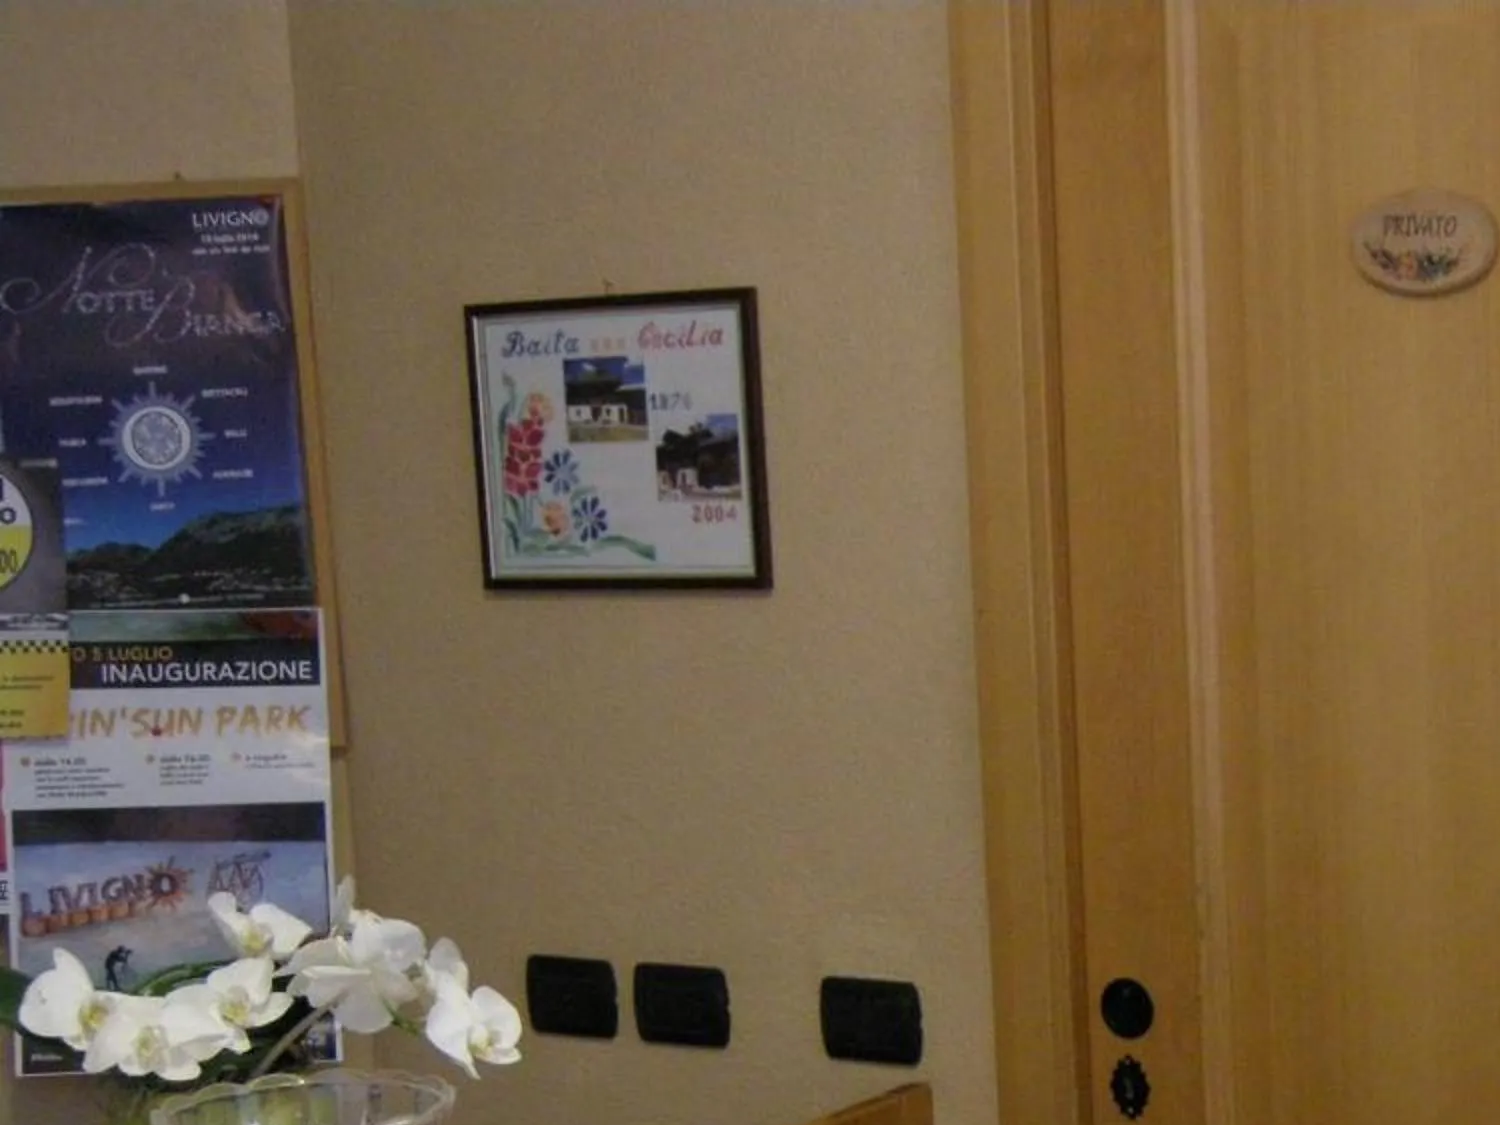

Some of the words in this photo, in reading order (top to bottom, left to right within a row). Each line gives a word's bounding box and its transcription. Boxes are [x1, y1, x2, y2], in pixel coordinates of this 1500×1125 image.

[192, 208, 269, 229] LIVIGNO
[502, 328, 580, 357] Baita
[108, 645, 174, 662] LUGLIO
[101, 660, 313, 684] INAUGURAZIONE
[215, 703, 313, 737] PARK
